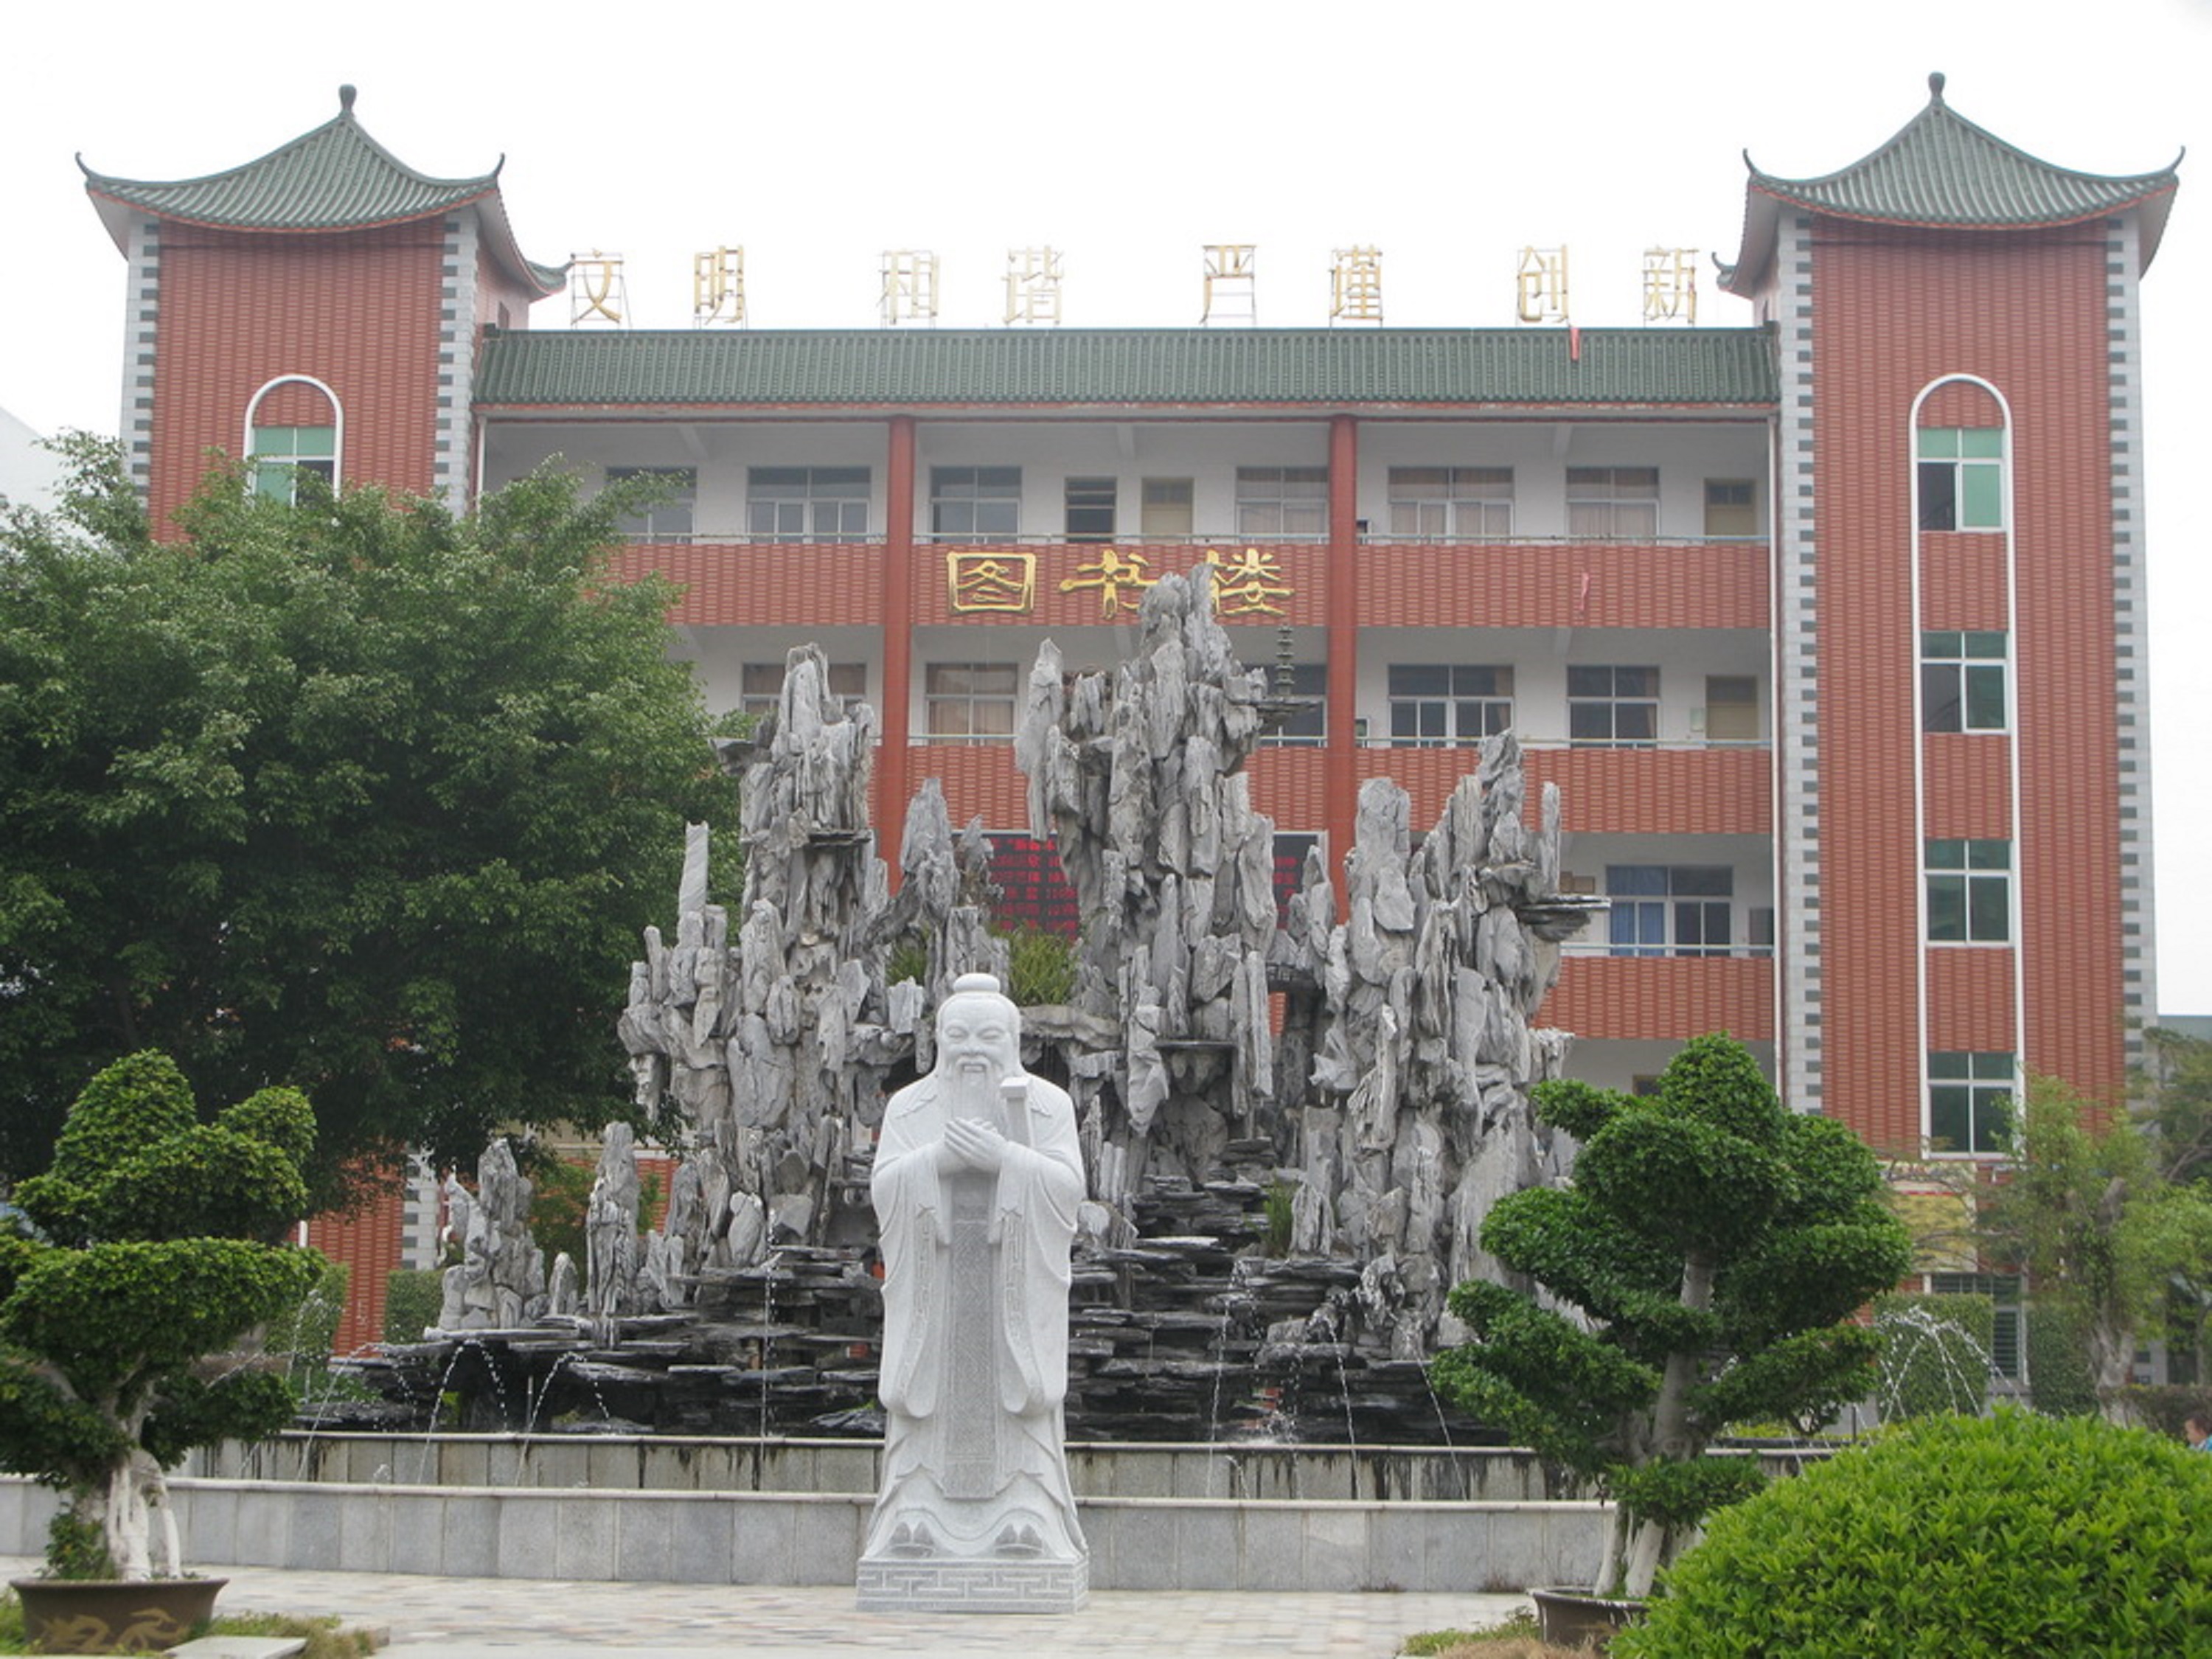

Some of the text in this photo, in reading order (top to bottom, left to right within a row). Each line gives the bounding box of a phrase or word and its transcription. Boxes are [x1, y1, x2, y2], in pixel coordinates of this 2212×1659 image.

[571, 245, 1700, 325] 文明 和谐 严谨 创新
